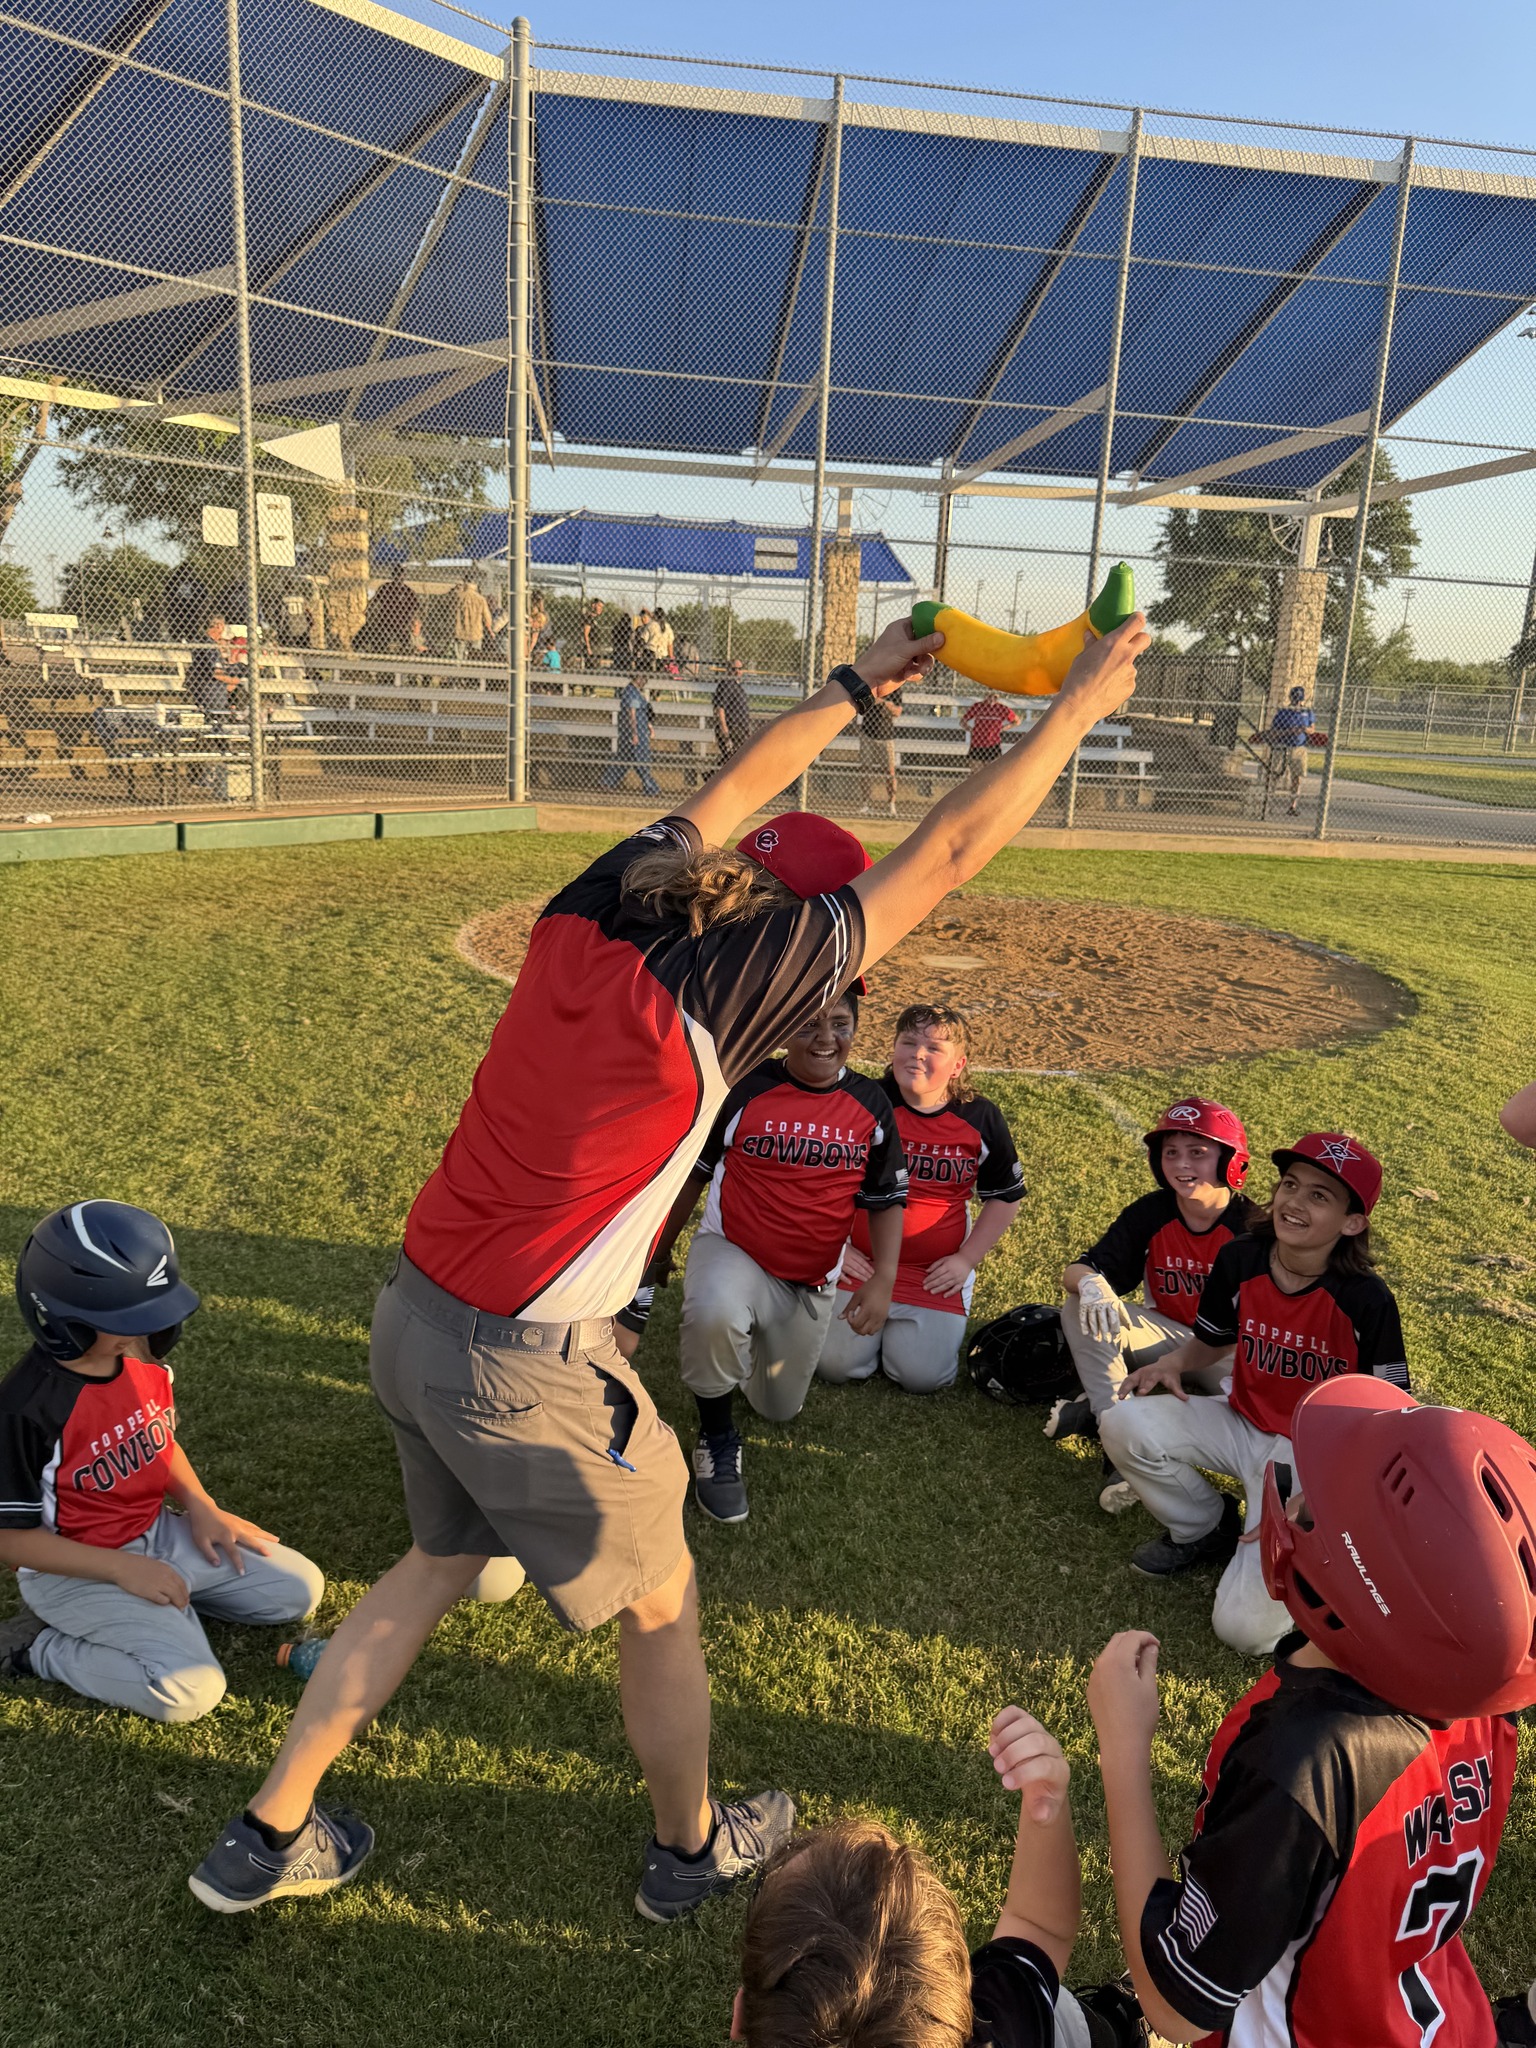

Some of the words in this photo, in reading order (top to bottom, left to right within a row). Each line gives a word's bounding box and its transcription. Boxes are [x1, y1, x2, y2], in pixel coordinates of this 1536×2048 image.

[765, 1120, 855, 1143] COPPELL
[742, 1134, 869, 1171] COWBOYS
[1246, 1318, 1329, 1355] COPPELL
[90, 1398, 161, 1457] COPPELL
[1394, 1845, 1485, 2048] 7
